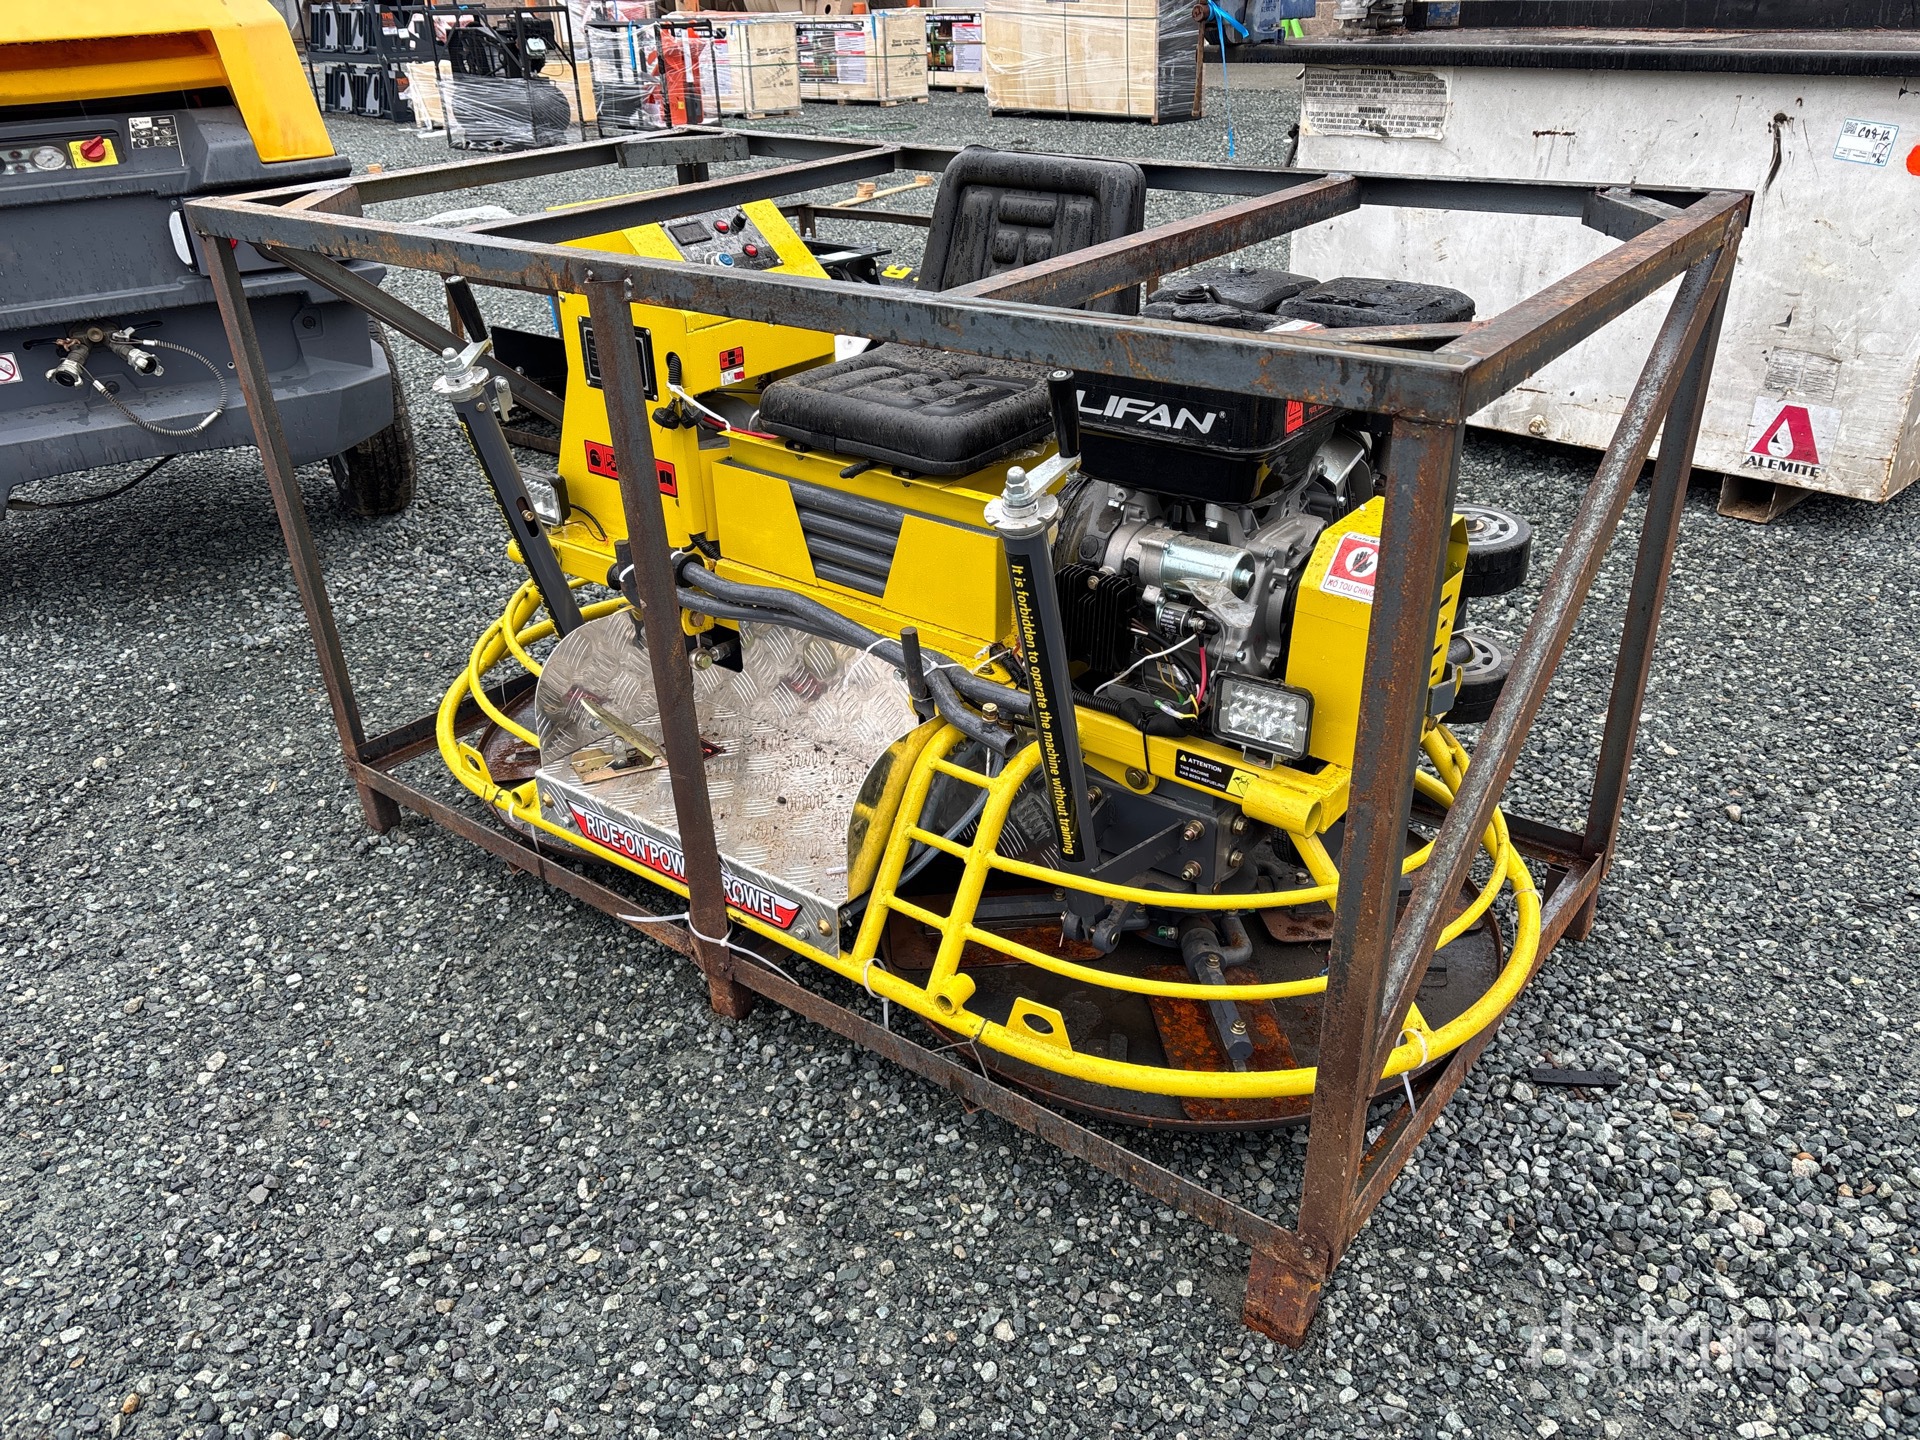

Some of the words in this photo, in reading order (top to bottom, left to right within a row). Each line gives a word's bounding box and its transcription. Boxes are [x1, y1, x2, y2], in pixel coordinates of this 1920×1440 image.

[1076, 390, 1217, 434] LIFAN
[1744, 455, 1821, 477] ALEMITE
[1012, 565, 1024, 574] It
[1014, 578, 1024, 588] is
[1016, 588, 1036, 648] forbidden
[1026, 650, 1038, 664] to
[1030, 666, 1048, 709] operate
[1040, 710, 1052, 728] the
[1042, 730, 1060, 775] machine
[1188, 758, 1222, 773] ATTENTION
[1190, 767, 1210, 777] MACHINE
[1052, 776, 1068, 818] without
[1058, 818, 1075, 855] training
[585, 812, 648, 862] RIDE-ON
[649, 842, 686, 880] POW
[722, 874, 782, 923] ROWEL
